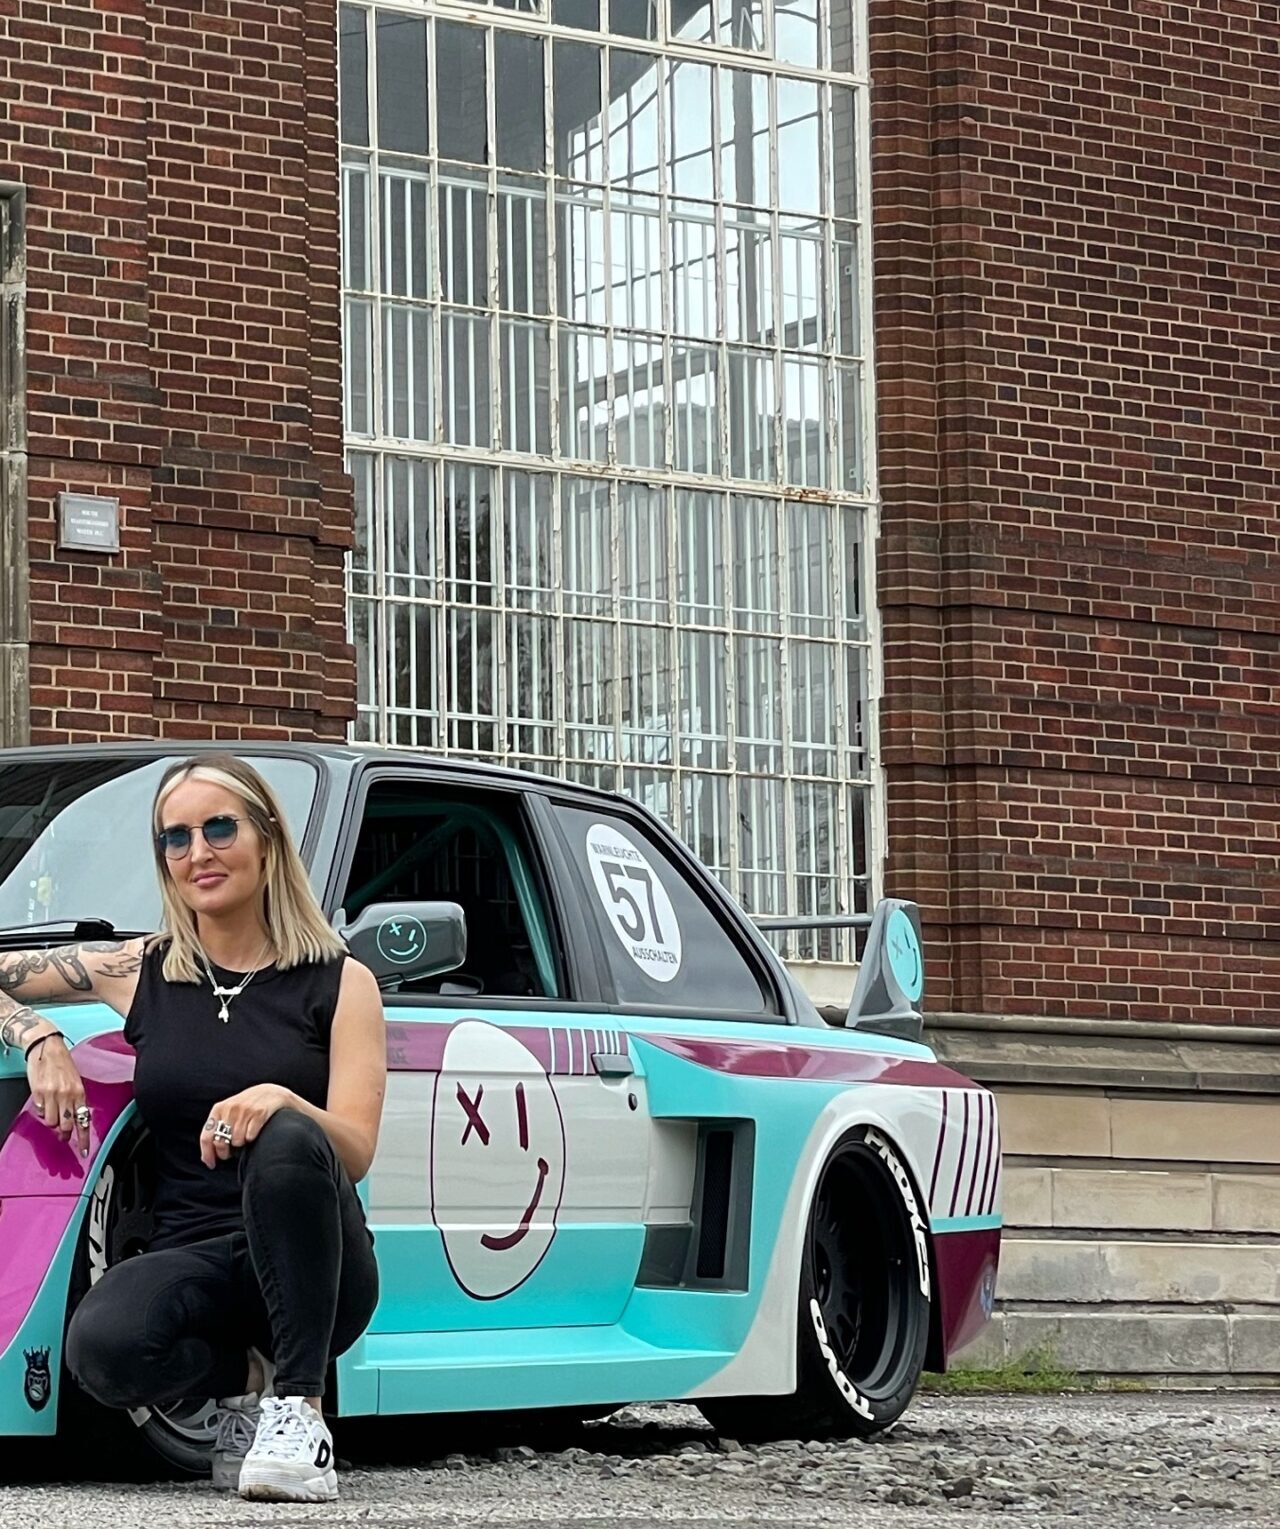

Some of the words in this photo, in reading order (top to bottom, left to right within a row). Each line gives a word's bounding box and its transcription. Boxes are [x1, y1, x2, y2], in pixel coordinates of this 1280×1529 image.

[590, 842, 642, 863] WARNLEUCHTE
[599, 860, 665, 945] 57
[631, 946, 678, 965] AUSSCHALTEN
[863, 1125, 932, 1303] PROXES
[809, 1297, 876, 1422] TOYO
